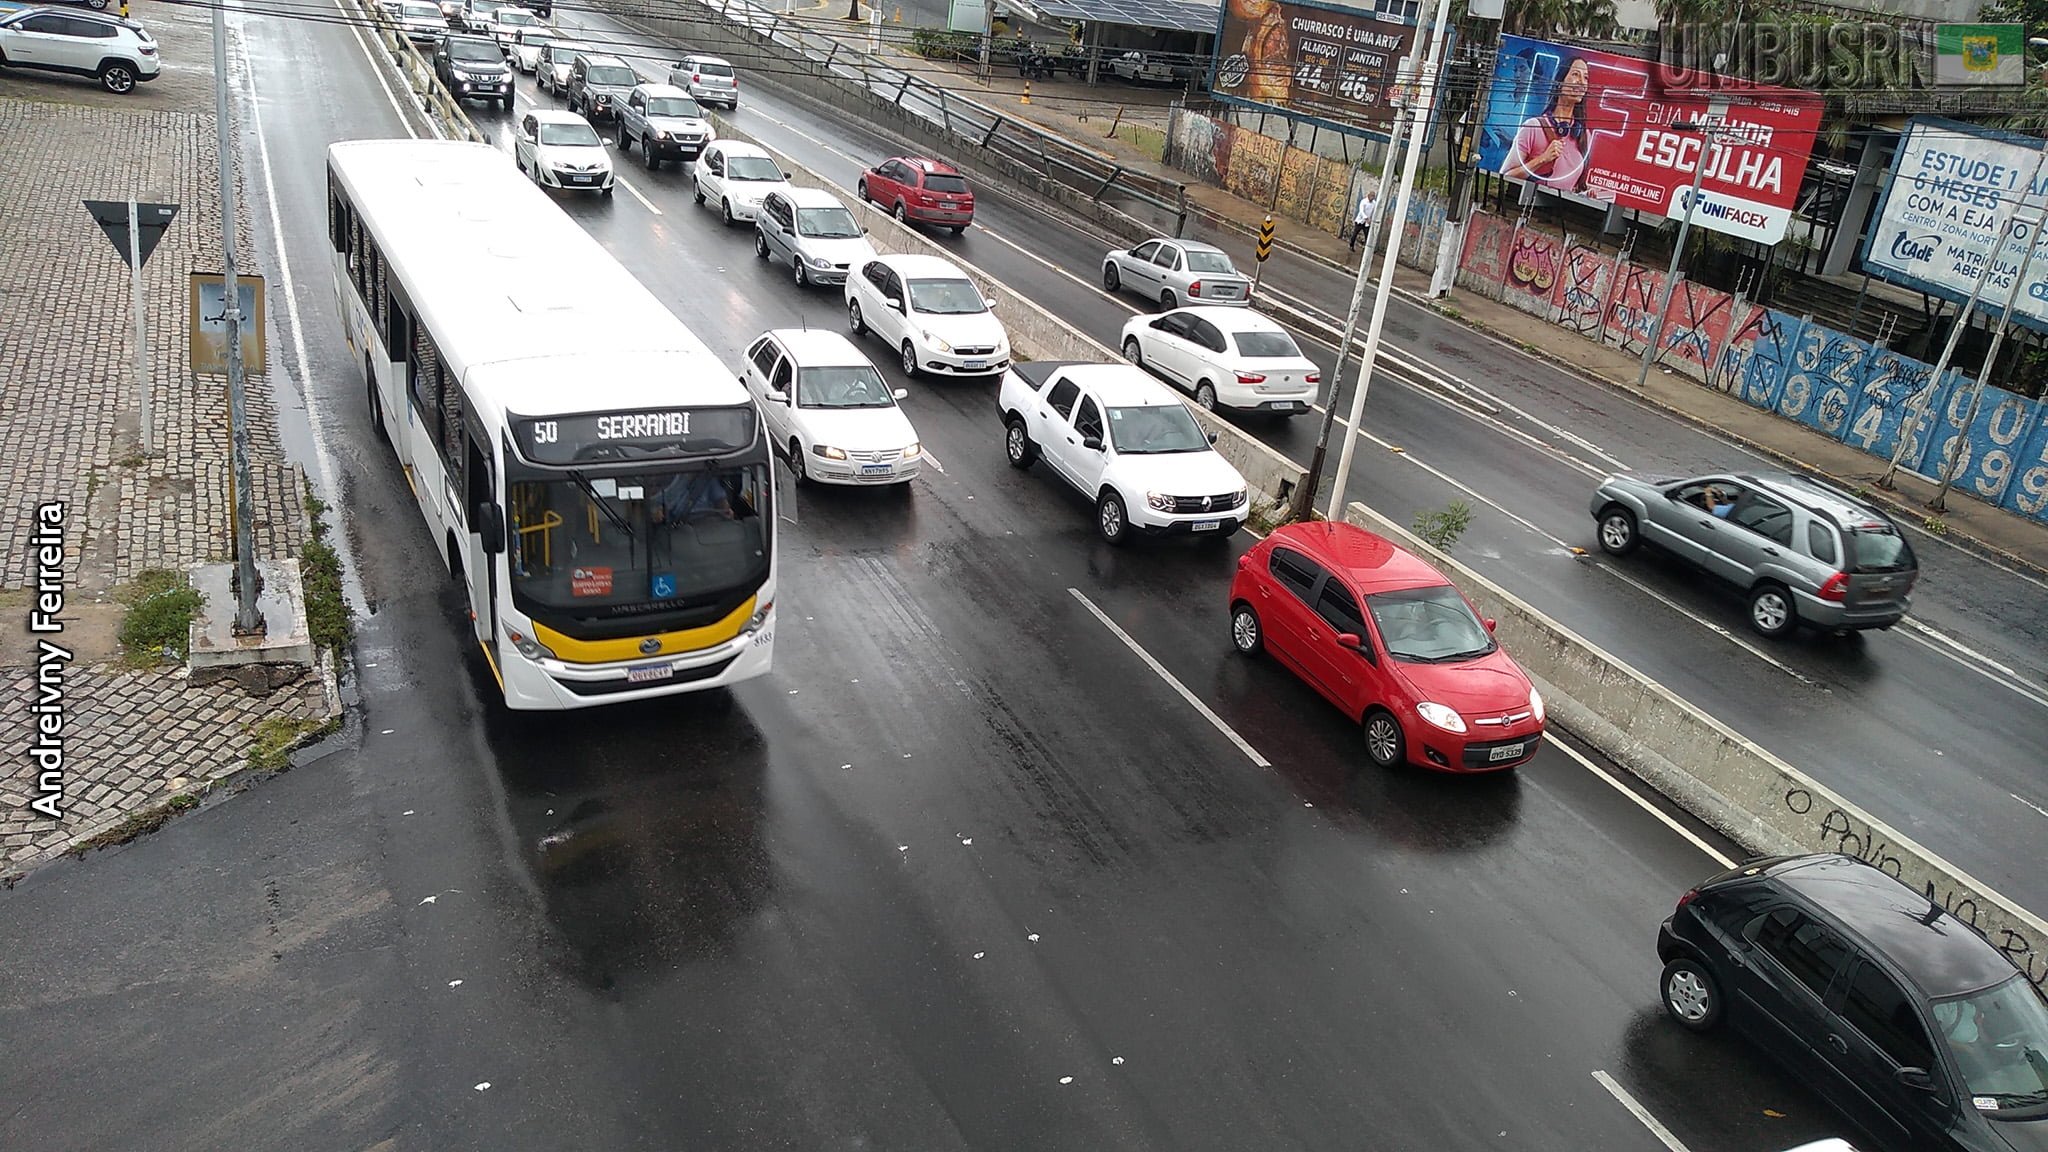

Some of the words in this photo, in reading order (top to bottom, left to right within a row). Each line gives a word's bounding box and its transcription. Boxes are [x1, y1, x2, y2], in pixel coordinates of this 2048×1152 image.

[1292, 17, 1344, 39] CHURRASCO
[1345, 25, 1352, 40] É
[1353, 28, 1374, 45] UMA
[1301, 41, 1338, 58] ALMOÇO
[1348, 51, 1382, 67] JANTAR
[1634, 128, 1782, 195] ESCOLHA
[1920, 149, 2005, 188] ESTUDE
[2007, 169, 2018, 190] 1
[1590, 174, 1629, 192] VESTIBULAR
[1630, 184, 1661, 200] ON-LINE
[1914, 171, 1928, 190] 6
[1930, 177, 2001, 211] MESES
[1702, 201, 1769, 230] UNIFACEX
[1902, 211, 1937, 228] CENTRO
[1942, 224, 1968, 238] ZONA
[1969, 232, 1999, 248] NORT
[1907, 194, 1944, 217] COM
[1945, 208, 1958, 221] A
[1962, 213, 1995, 232] EJA
[1947, 245, 2019, 278] MATRÍULA
[534, 421, 558, 444] 50
[597, 411, 691, 439] SERRAMBI
[1785, 787, 1812, 814] O
